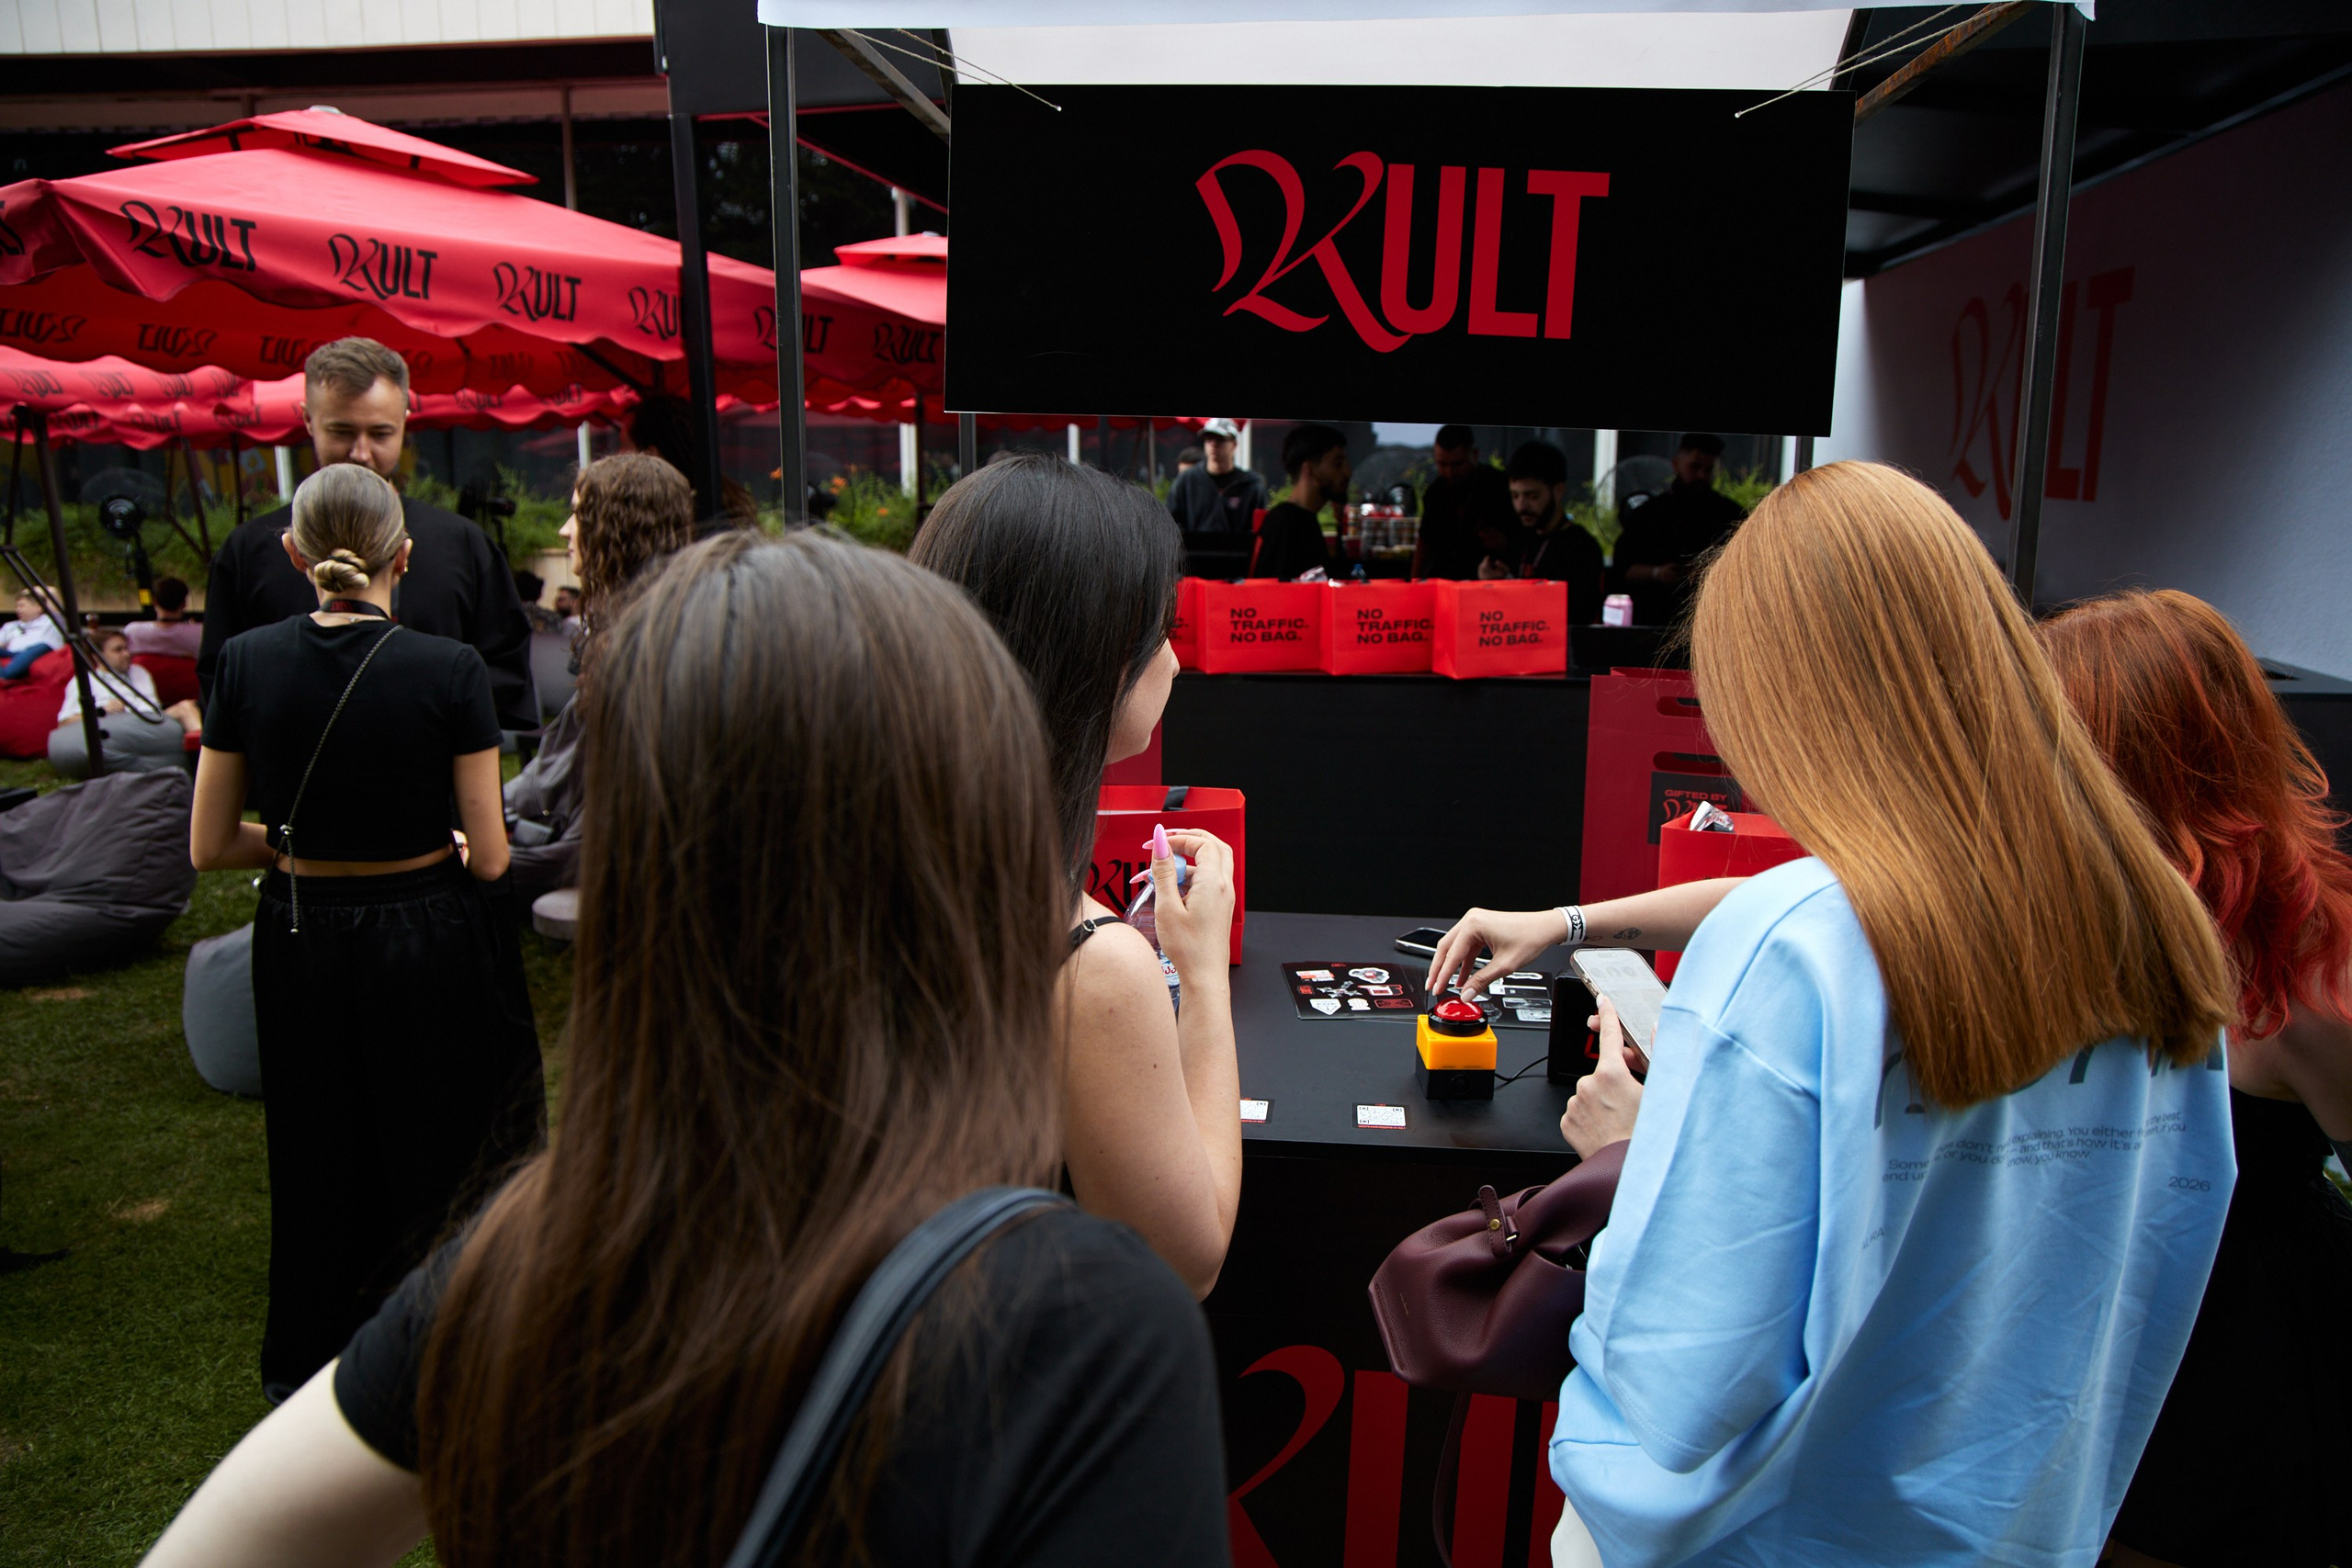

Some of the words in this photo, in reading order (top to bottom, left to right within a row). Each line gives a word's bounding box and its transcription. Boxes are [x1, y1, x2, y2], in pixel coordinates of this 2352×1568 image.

[119, 200, 256, 272] KULT
[1195, 150, 1610, 353] KULT
[328, 233, 437, 299] KULT
[492, 261, 581, 321] KULT
[628, 286, 677, 341] KU
[752, 306, 832, 354] KLT
[872, 322, 941, 365] KULT
[1230, 607, 1257, 618] NO
[1357, 608, 1383, 619] NO
[1479, 611, 1503, 622] NO
[1230, 618, 1309, 631] TRAFFIC.
[1357, 618, 1434, 631] TRAFFIC.
[1479, 620, 1550, 634] TRAFFIC.
[1230, 632, 1257, 643] NO
[1261, 631, 1302, 642] BAG.
[1357, 633, 1383, 644] NO
[1387, 631, 1428, 643] BAG.
[1479, 636, 1503, 647] NO
[1506, 634, 1544, 646] BAG.
[1664, 789, 1709, 800] GIFTED
[1711, 793, 1728, 802] BY
[1089, 860, 1152, 914] KU
[2068, 1126, 2089, 1136] You
[2092, 1125, 2135, 1139] either
[2076, 1137, 2107, 1149] how
[2168, 1176, 2211, 1192] 2026
